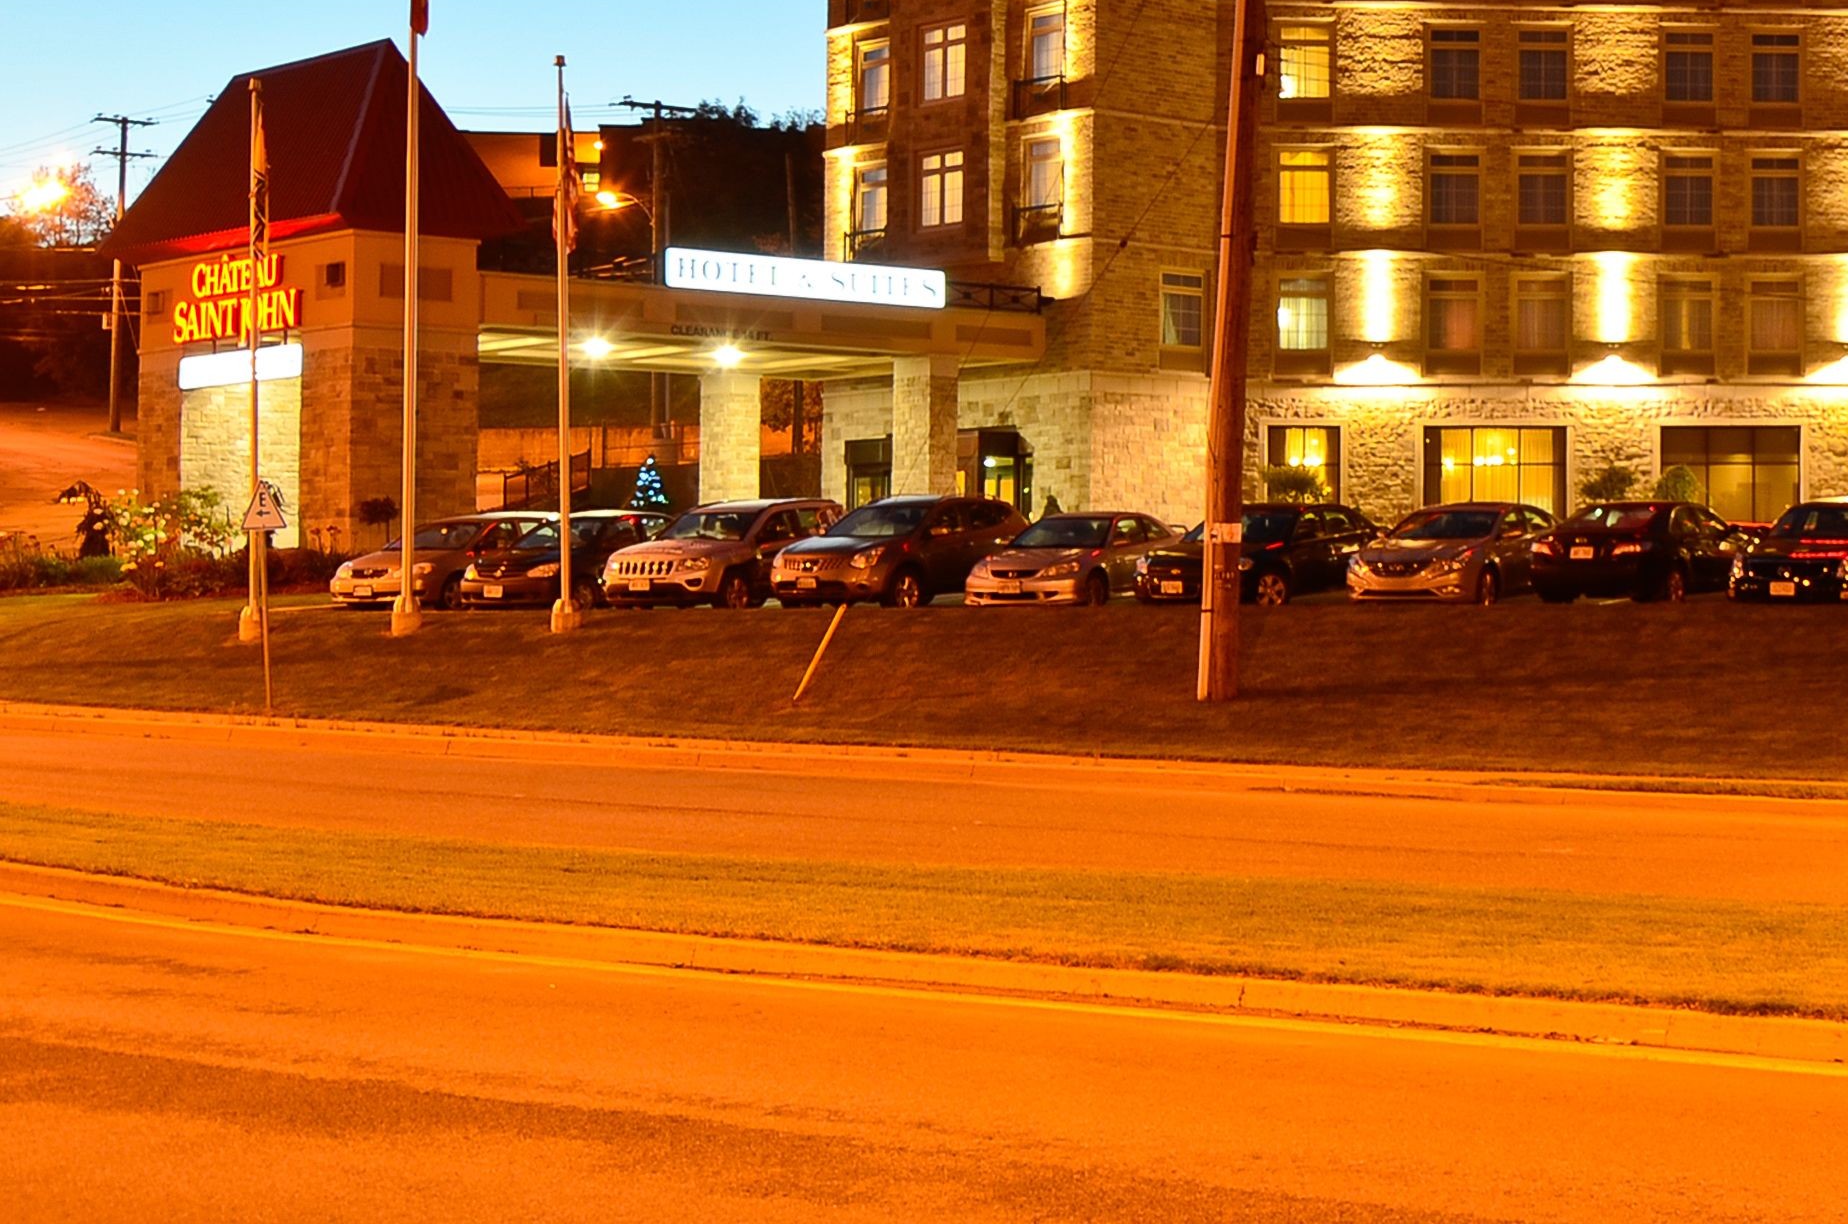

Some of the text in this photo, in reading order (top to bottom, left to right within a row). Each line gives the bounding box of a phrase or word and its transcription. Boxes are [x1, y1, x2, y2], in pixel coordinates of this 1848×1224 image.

[678, 257, 777, 286] HOTEL
[831, 272, 938, 297] SUITES
[173, 287, 297, 349] SAINT JOHN
[258, 491, 267, 507] E
